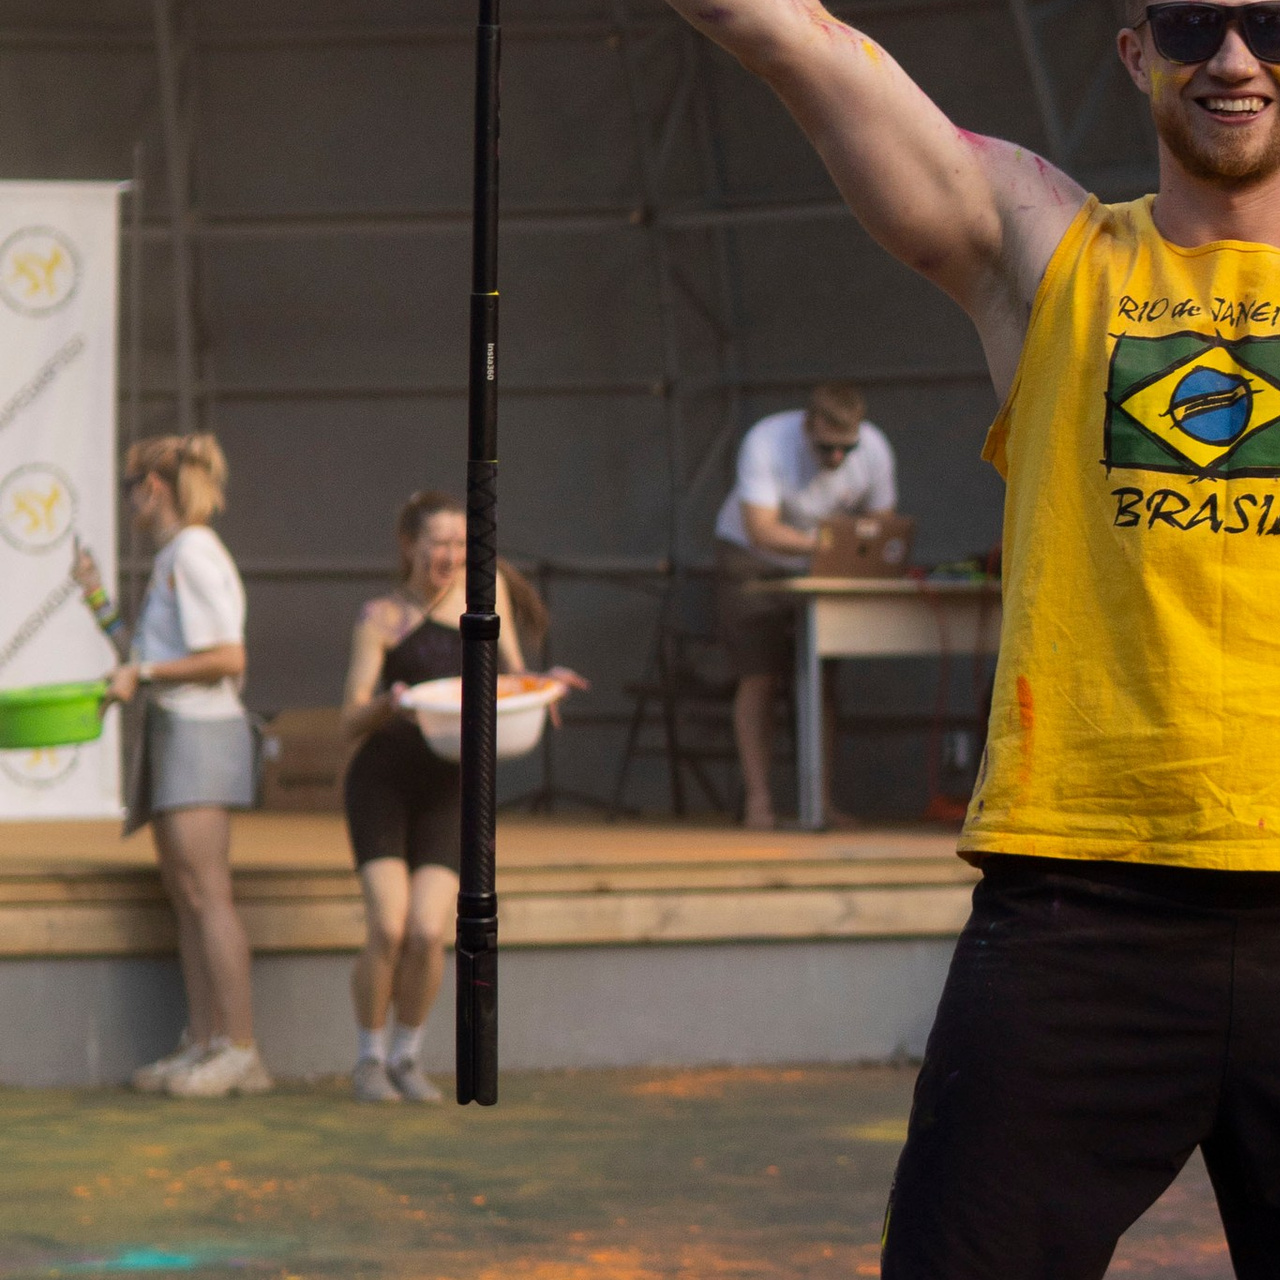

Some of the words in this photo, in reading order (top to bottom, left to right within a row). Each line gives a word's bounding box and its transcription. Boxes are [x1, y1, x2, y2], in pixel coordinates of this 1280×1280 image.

[1117, 295, 1169, 322] RIO
[1171, 298, 1201, 319] de
[486, 342, 495, 381] Insta360
